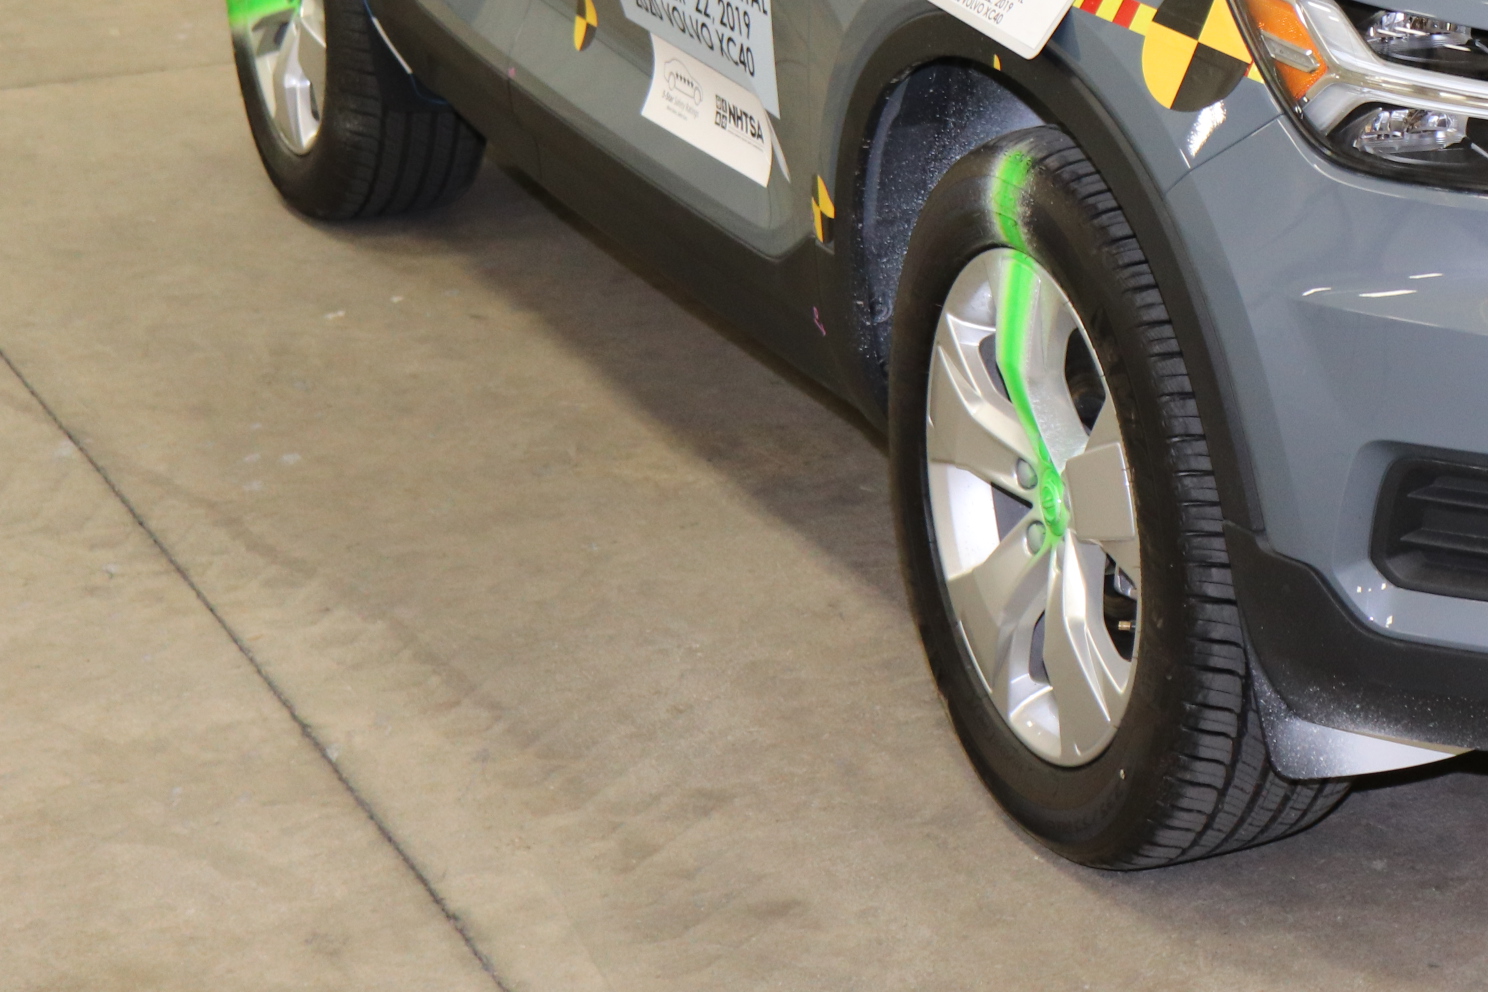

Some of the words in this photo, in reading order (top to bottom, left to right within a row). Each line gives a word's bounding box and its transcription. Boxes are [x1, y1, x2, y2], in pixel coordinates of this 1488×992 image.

[983, 6, 1004, 25] XC40
[661, 0, 714, 51] VOLVO
[715, 28, 756, 77] XC40
[728, 102, 764, 144] NHTSA
